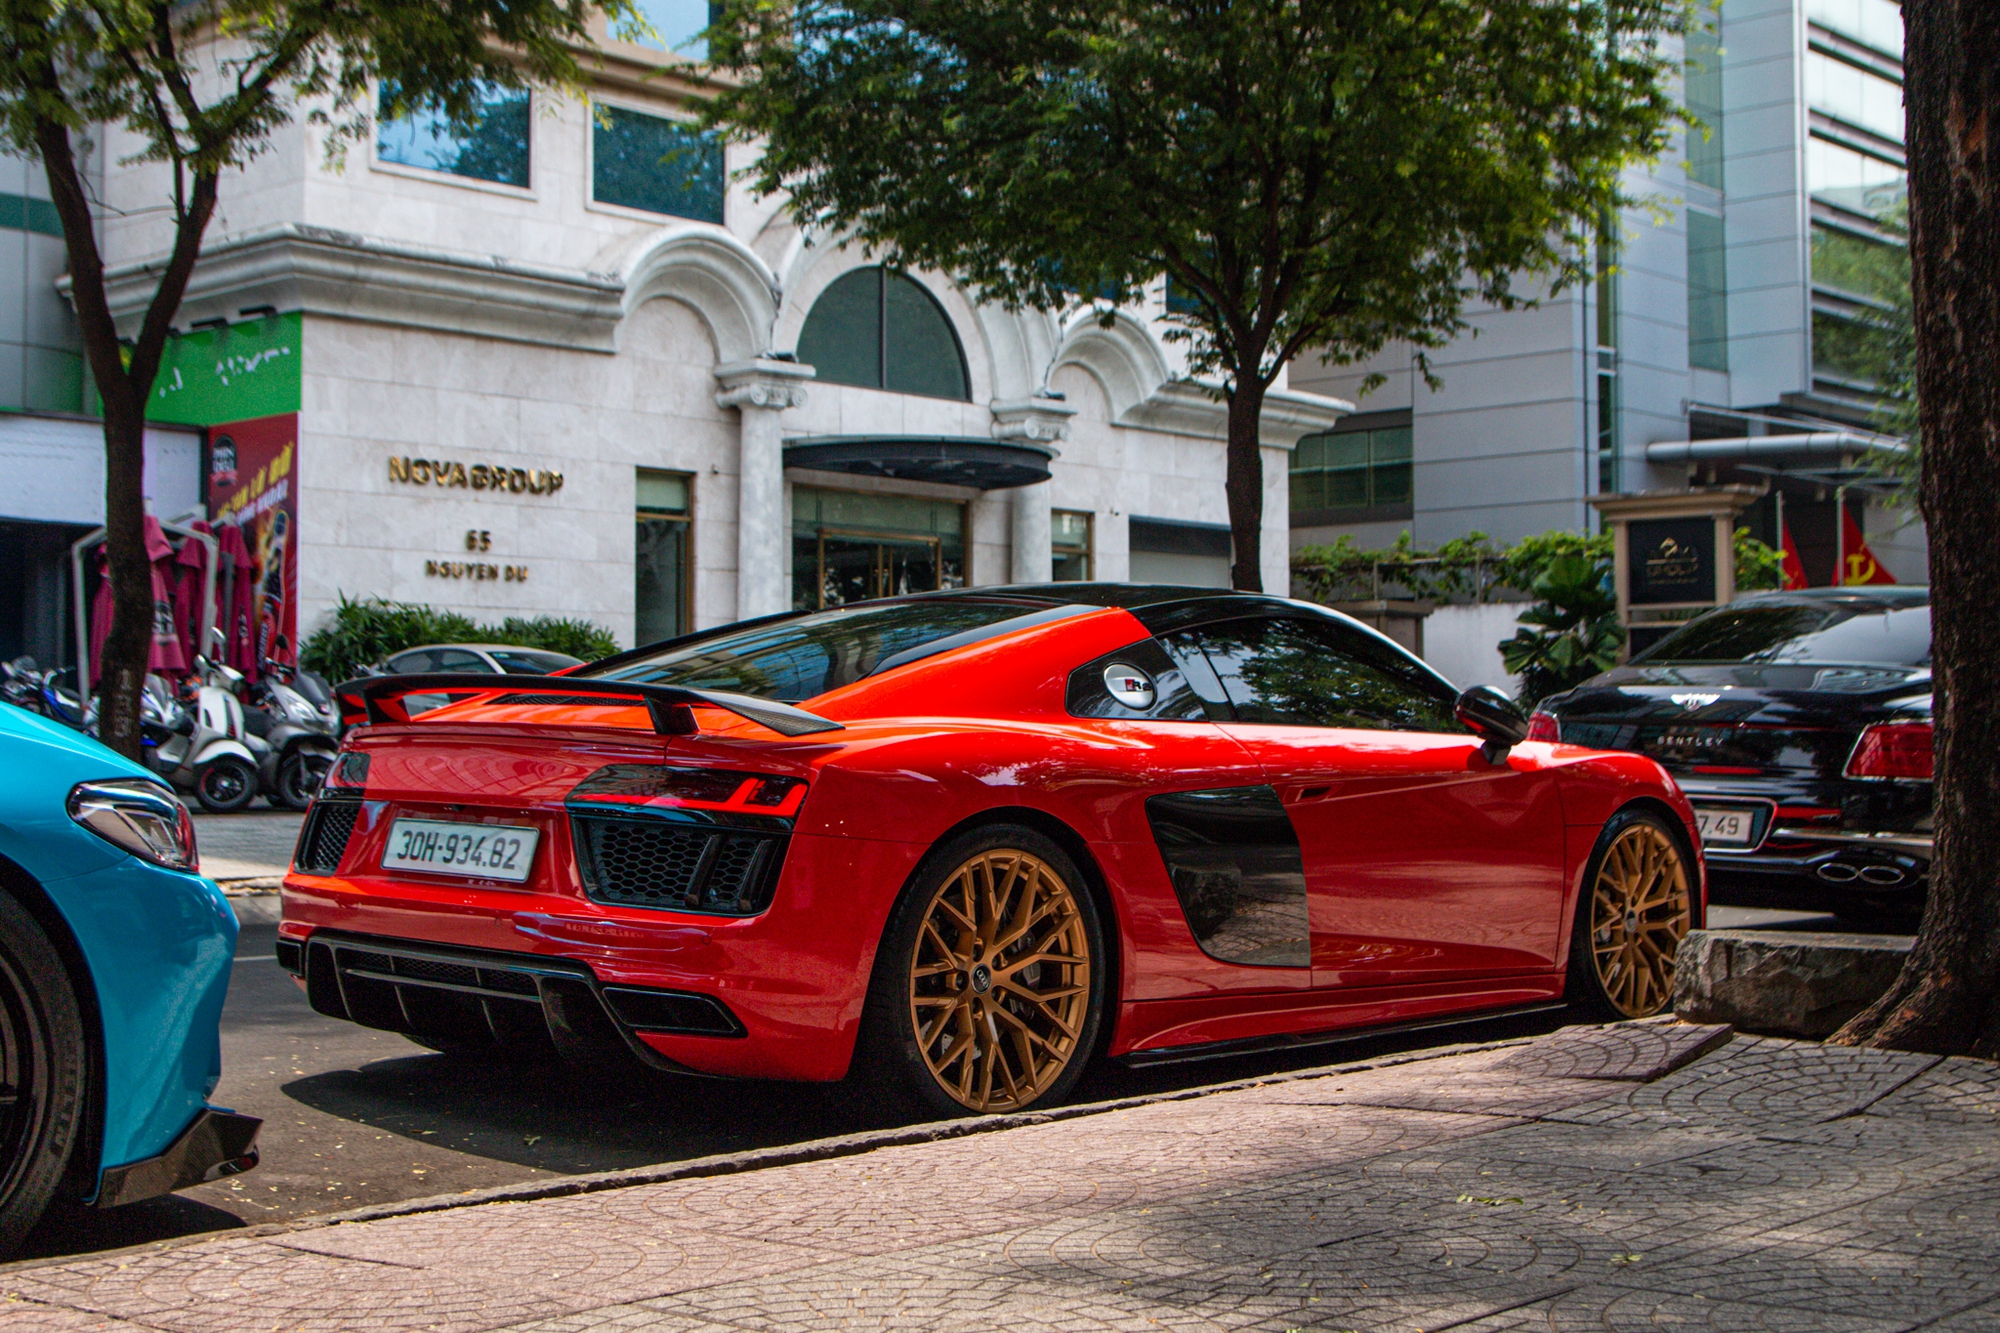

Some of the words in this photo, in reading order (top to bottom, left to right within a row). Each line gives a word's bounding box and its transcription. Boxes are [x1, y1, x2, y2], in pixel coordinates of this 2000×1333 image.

[389, 455, 564, 495] NOVAGROUP
[466, 529, 492, 552] 65
[425, 559, 499, 580] NGUYEN
[504, 565, 529, 582] DU
[1657, 735, 1724, 747] BENTLEY
[397, 830, 521, 870] 30H-934.82
